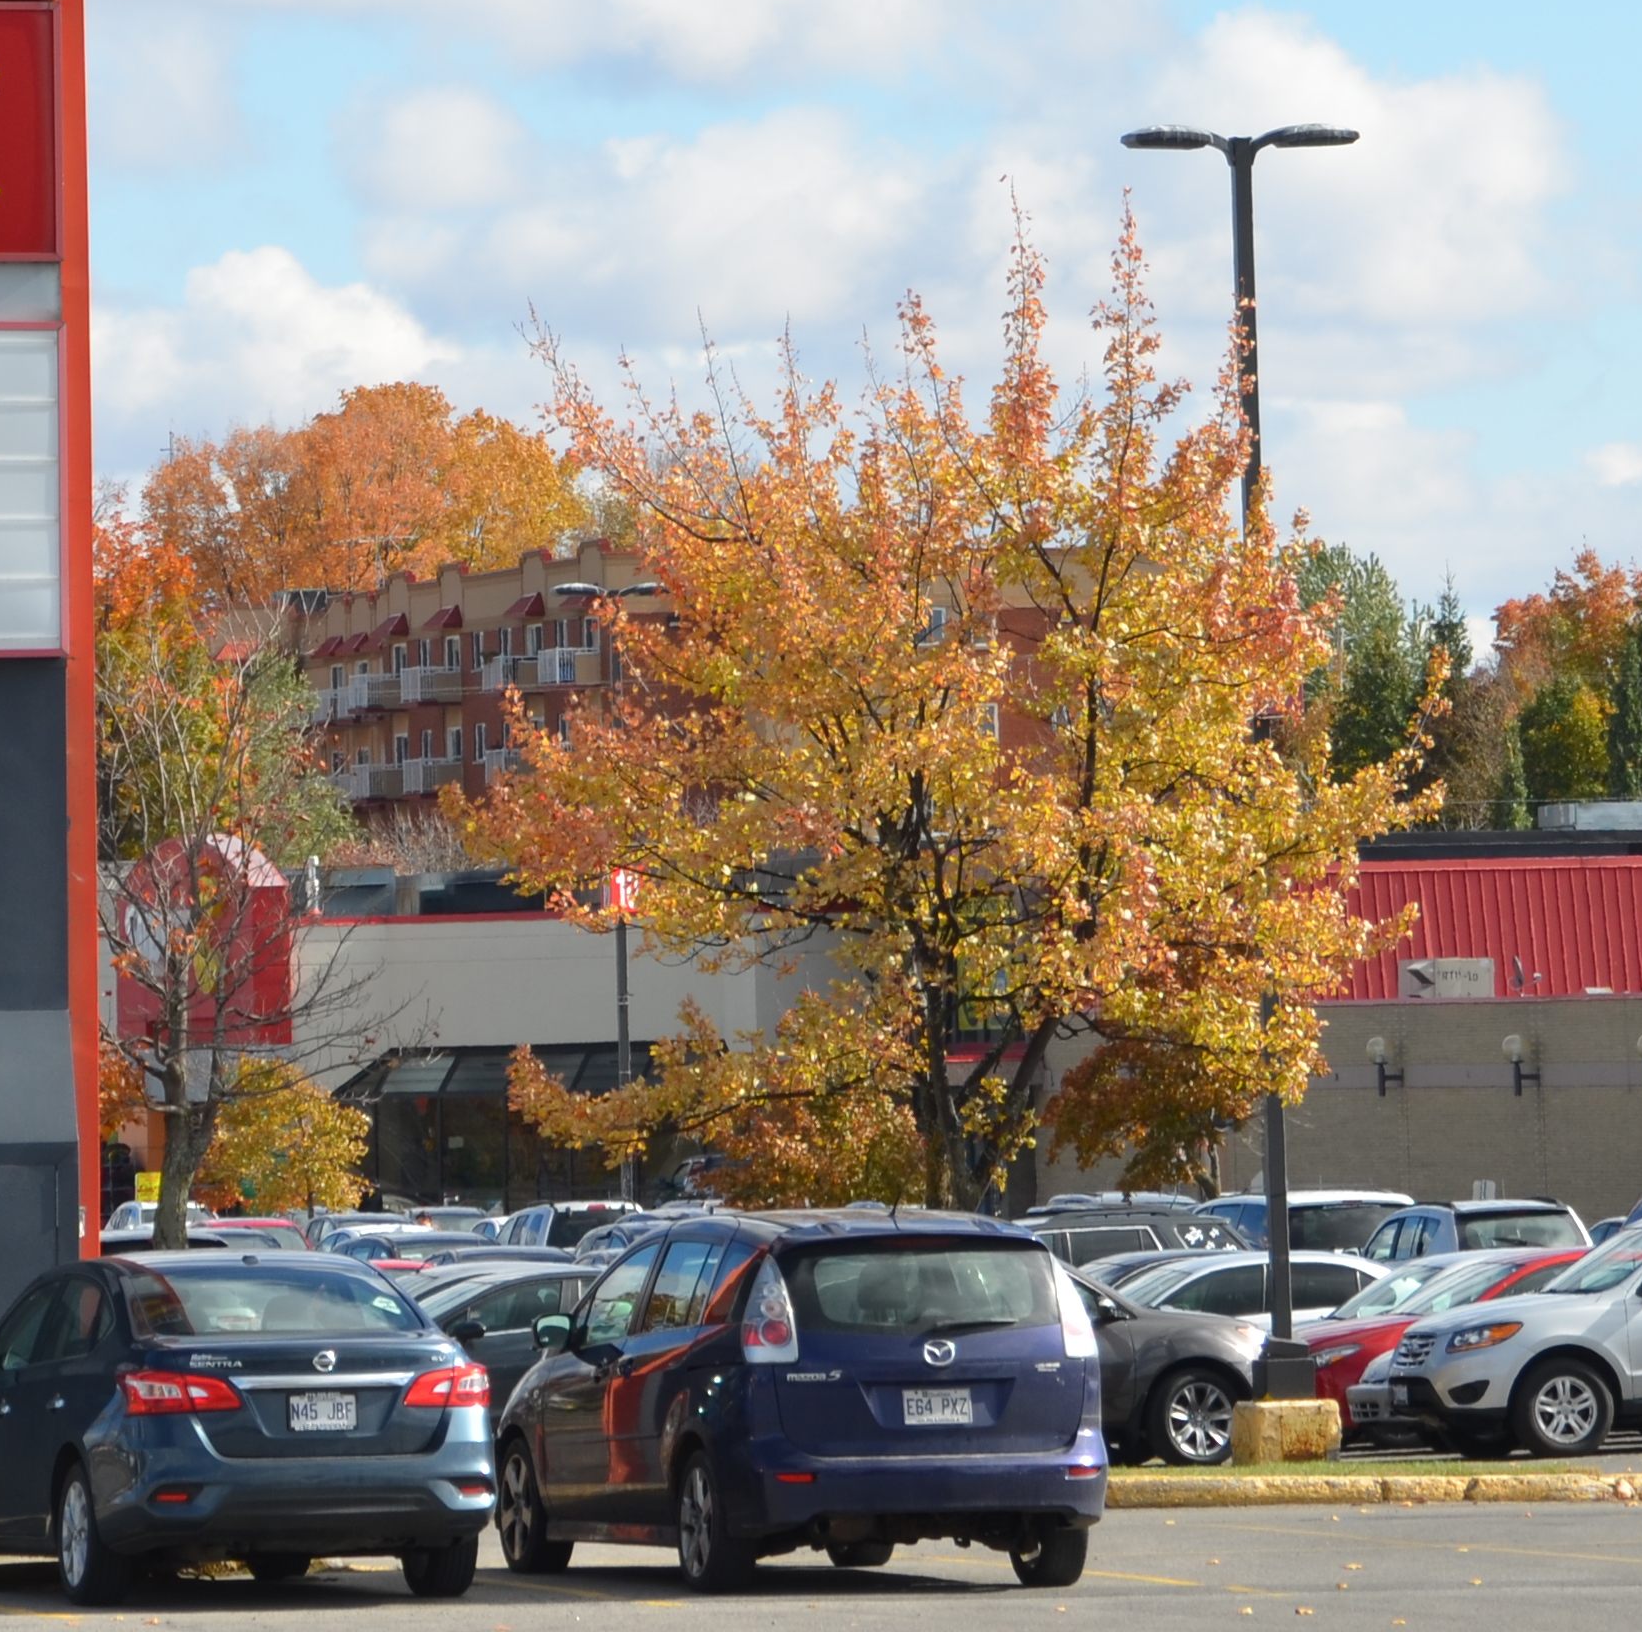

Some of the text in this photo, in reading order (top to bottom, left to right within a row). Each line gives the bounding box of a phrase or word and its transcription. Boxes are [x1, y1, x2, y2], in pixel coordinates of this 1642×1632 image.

[189, 1360, 243, 1369] SENTRA
[291, 1401, 354, 1421] N45 JBF
[906, 1397, 968, 1416] E64 PXZ
